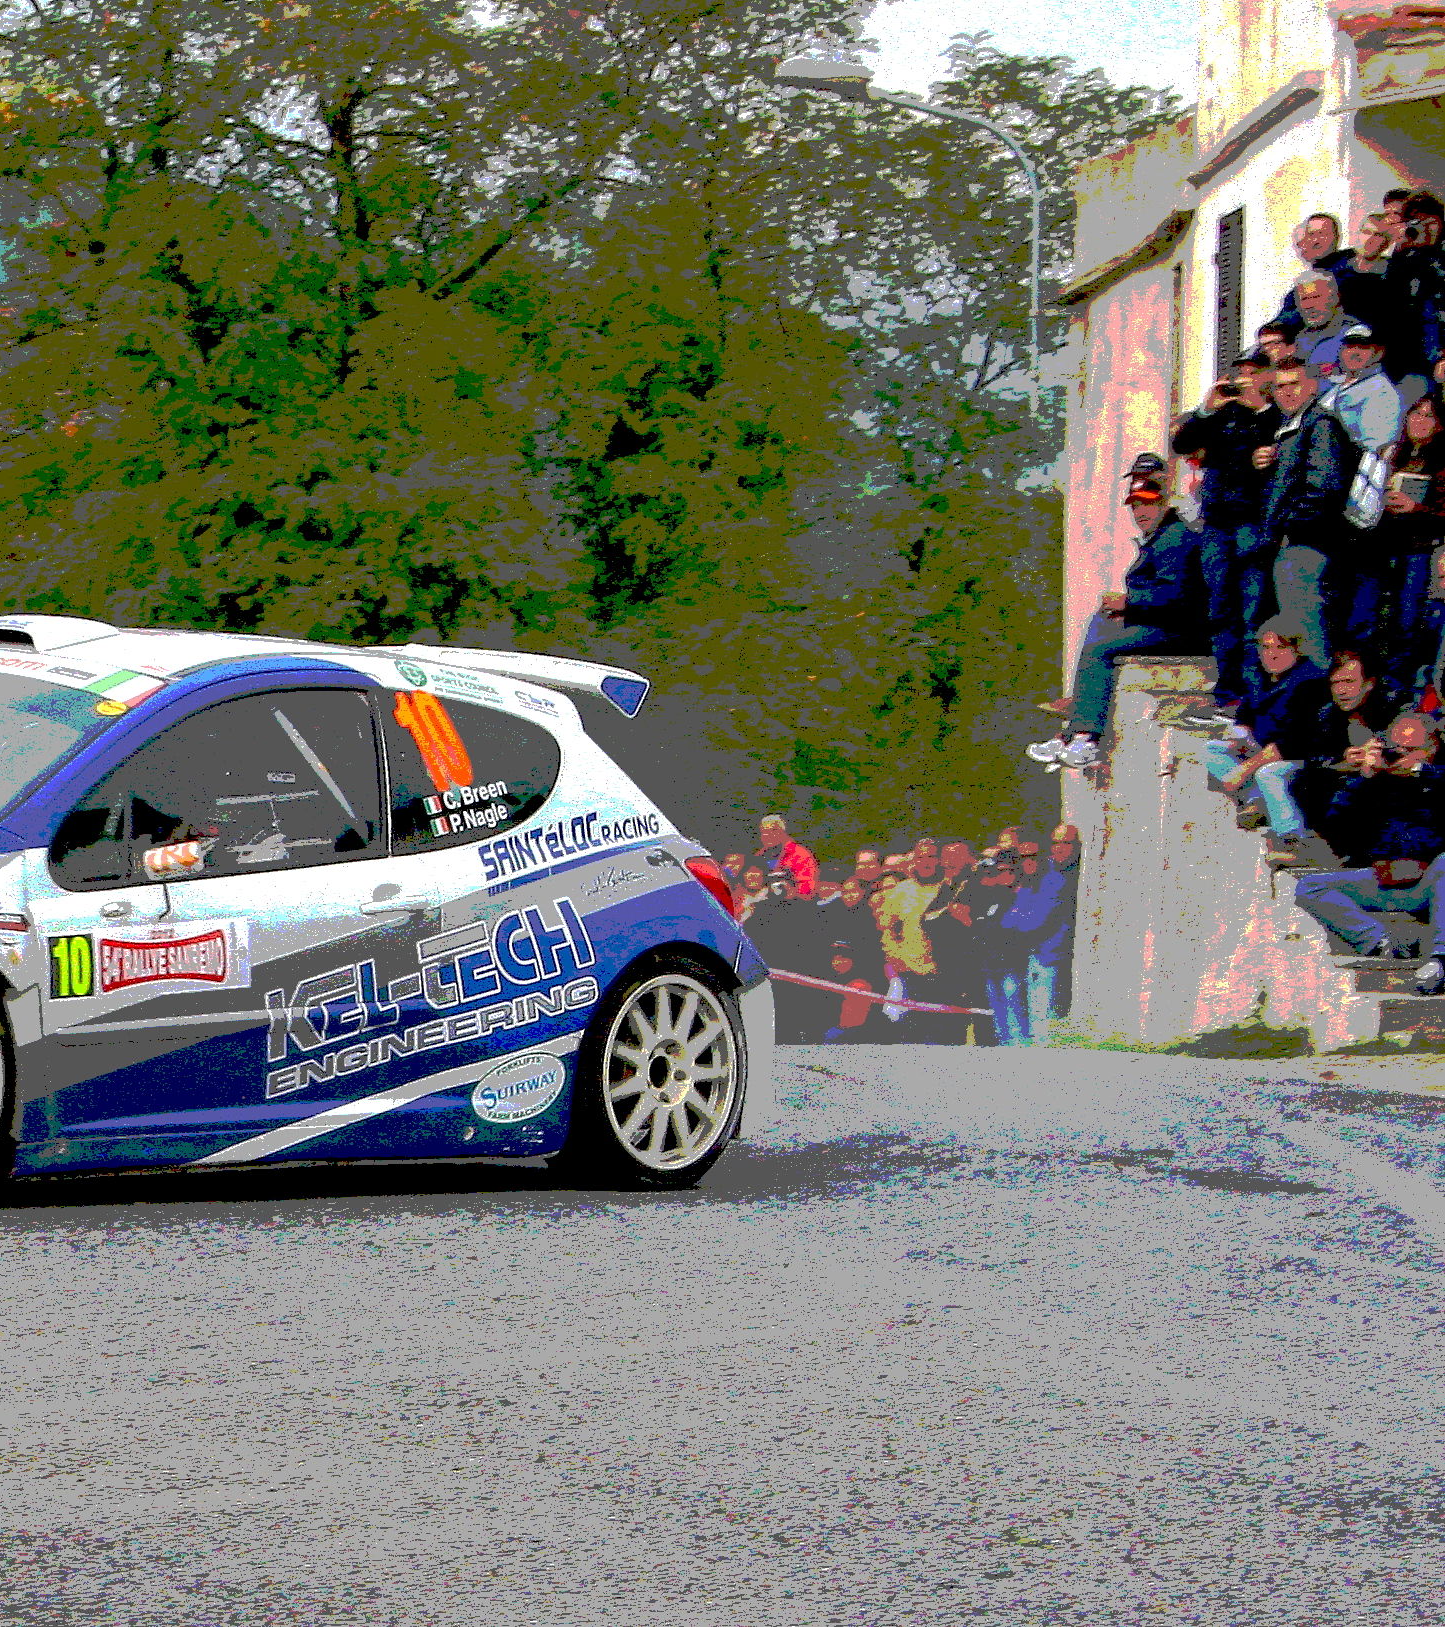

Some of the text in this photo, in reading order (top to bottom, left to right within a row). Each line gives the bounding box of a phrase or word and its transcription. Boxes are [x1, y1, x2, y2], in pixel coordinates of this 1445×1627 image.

[393, 689, 474, 793] 10
[460, 780, 508, 806] Breen
[464, 802, 508, 829] Nagle
[602, 813, 660, 846] RACING
[52, 936, 93, 997] 10
[266, 976, 600, 1099] ENGINEERING
[496, 1056, 543, 1076] FORKLIFTS
